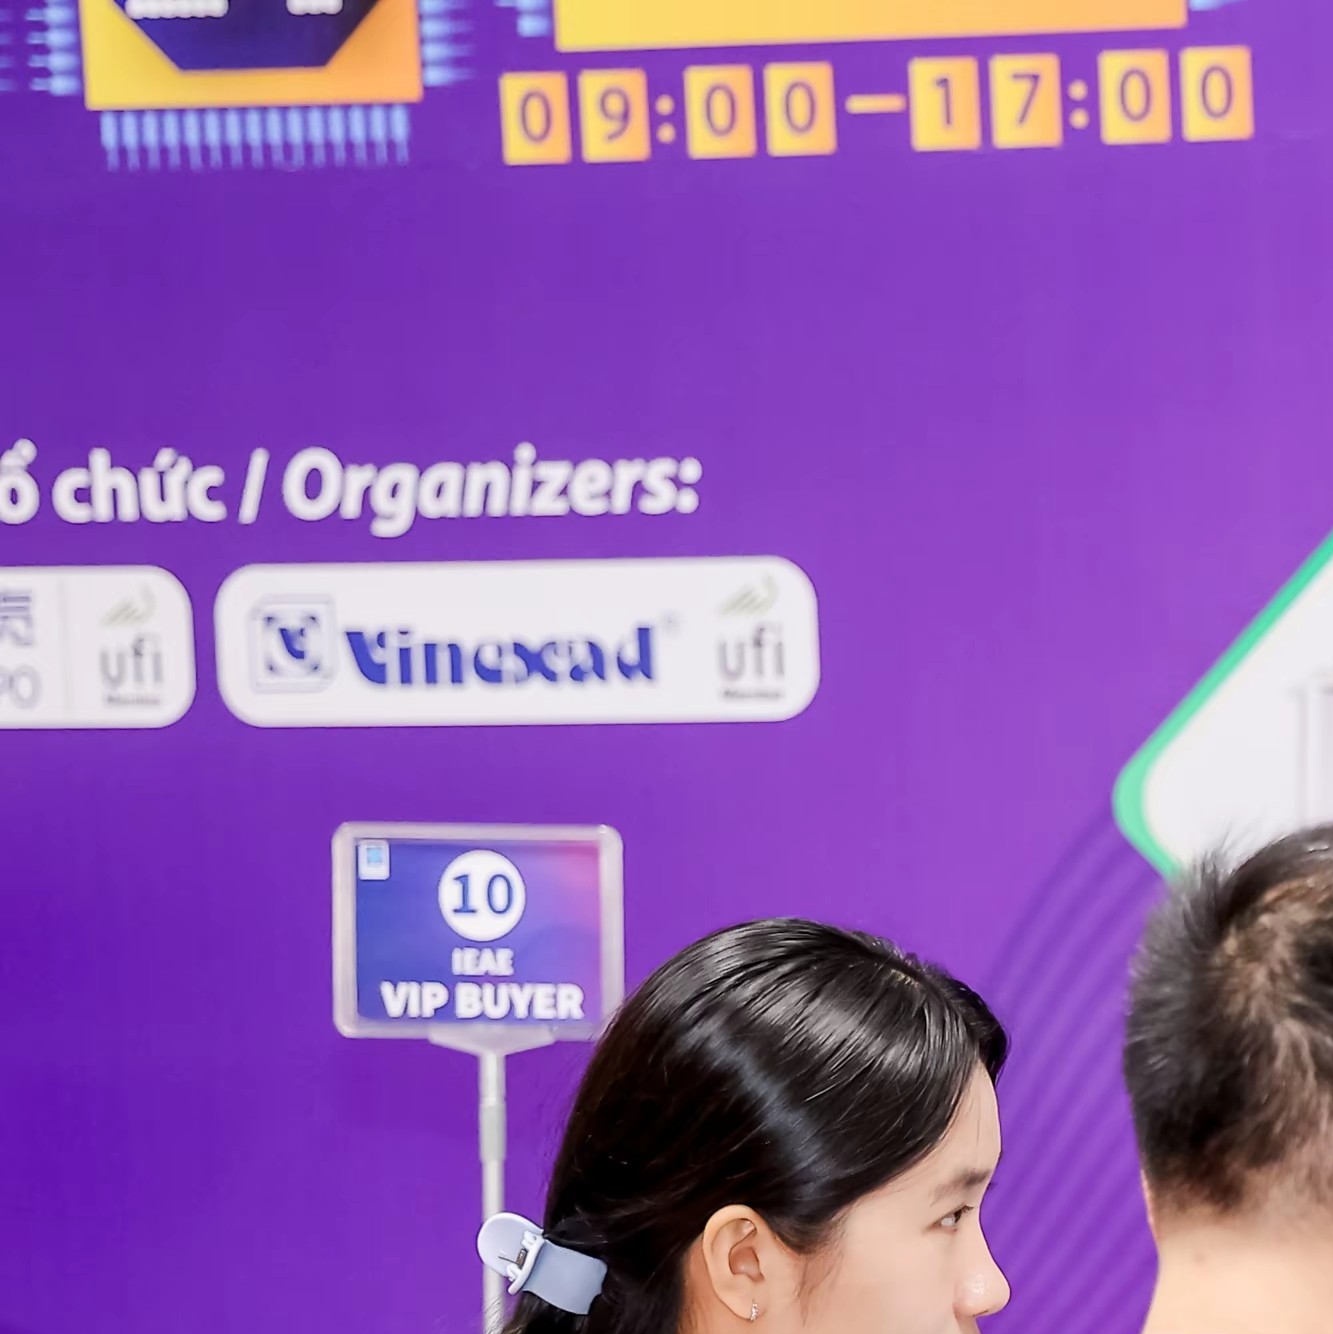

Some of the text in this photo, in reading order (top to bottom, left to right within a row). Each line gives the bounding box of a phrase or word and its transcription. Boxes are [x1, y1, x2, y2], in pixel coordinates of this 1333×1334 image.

[52, 446, 227, 525] chức
[237, 447, 270, 526] /
[282, 440, 703, 538] Organizers:
[452, 873, 513, 915] 10
[451, 947, 515, 977] IEAE
[380, 981, 585, 1020] VIP BUYER
